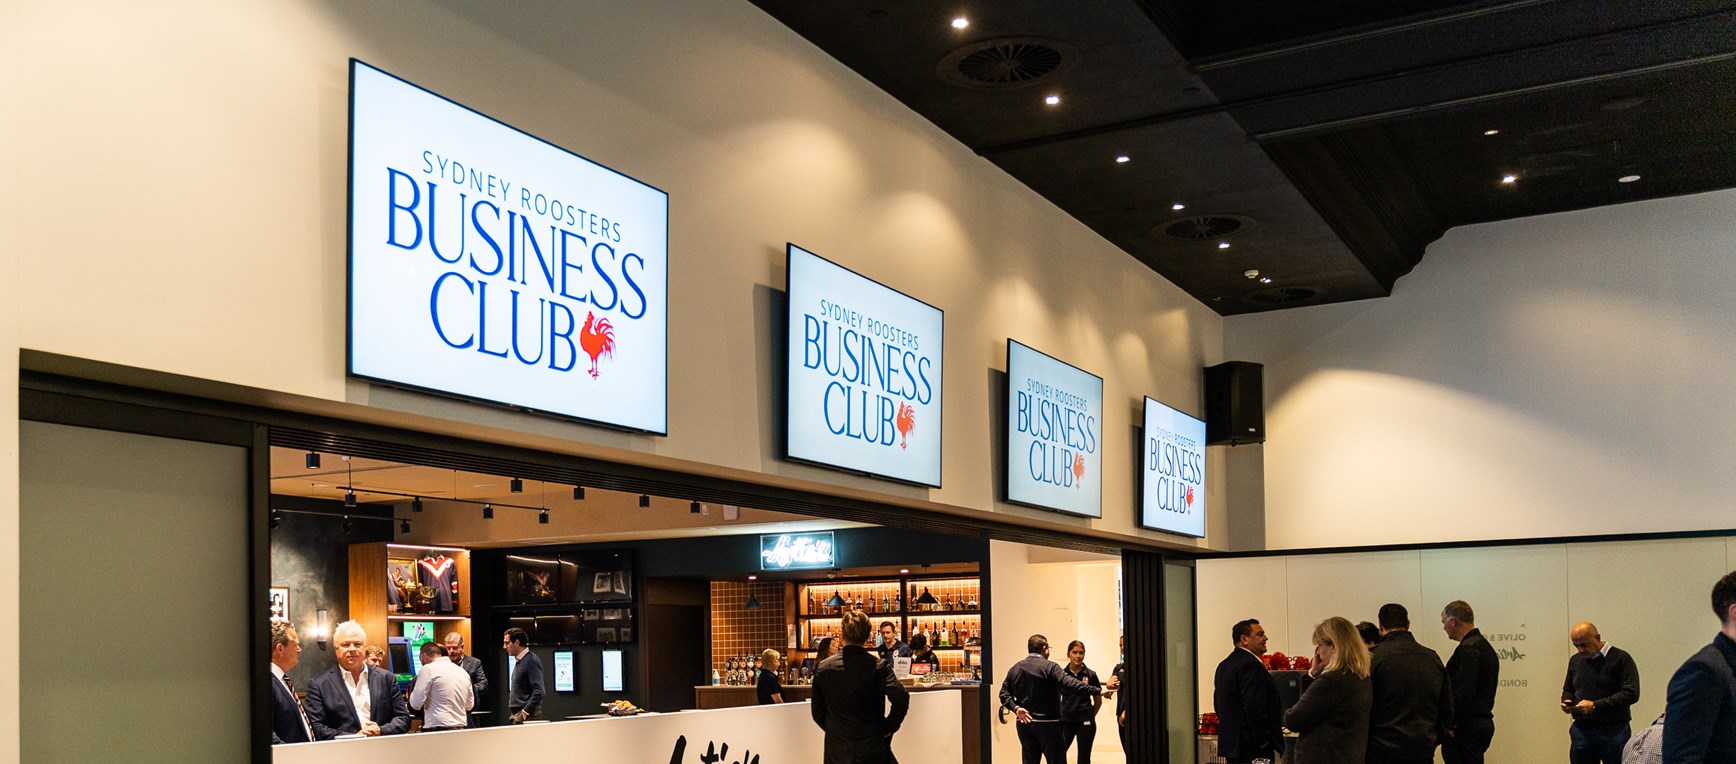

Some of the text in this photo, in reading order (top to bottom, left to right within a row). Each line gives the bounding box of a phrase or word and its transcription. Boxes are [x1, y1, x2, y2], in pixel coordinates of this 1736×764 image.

[423, 150, 621, 243] SYDNEY ROOSTERS
[386, 166, 647, 320] BUSINESS
[430, 271, 577, 373] CLUB
[820, 299, 919, 350] SYDNEY ROOSTERS
[803, 313, 932, 405] BUSINESS
[823, 381, 896, 447] CLUB
[1017, 390, 1096, 454] BUSINESS
[1027, 378, 1087, 412] SYDNEY ROOSTERS
[1029, 440, 1073, 488] CLUB
[1150, 437, 1202, 485] BUSINESS
[1157, 476, 1186, 514] CLUB
